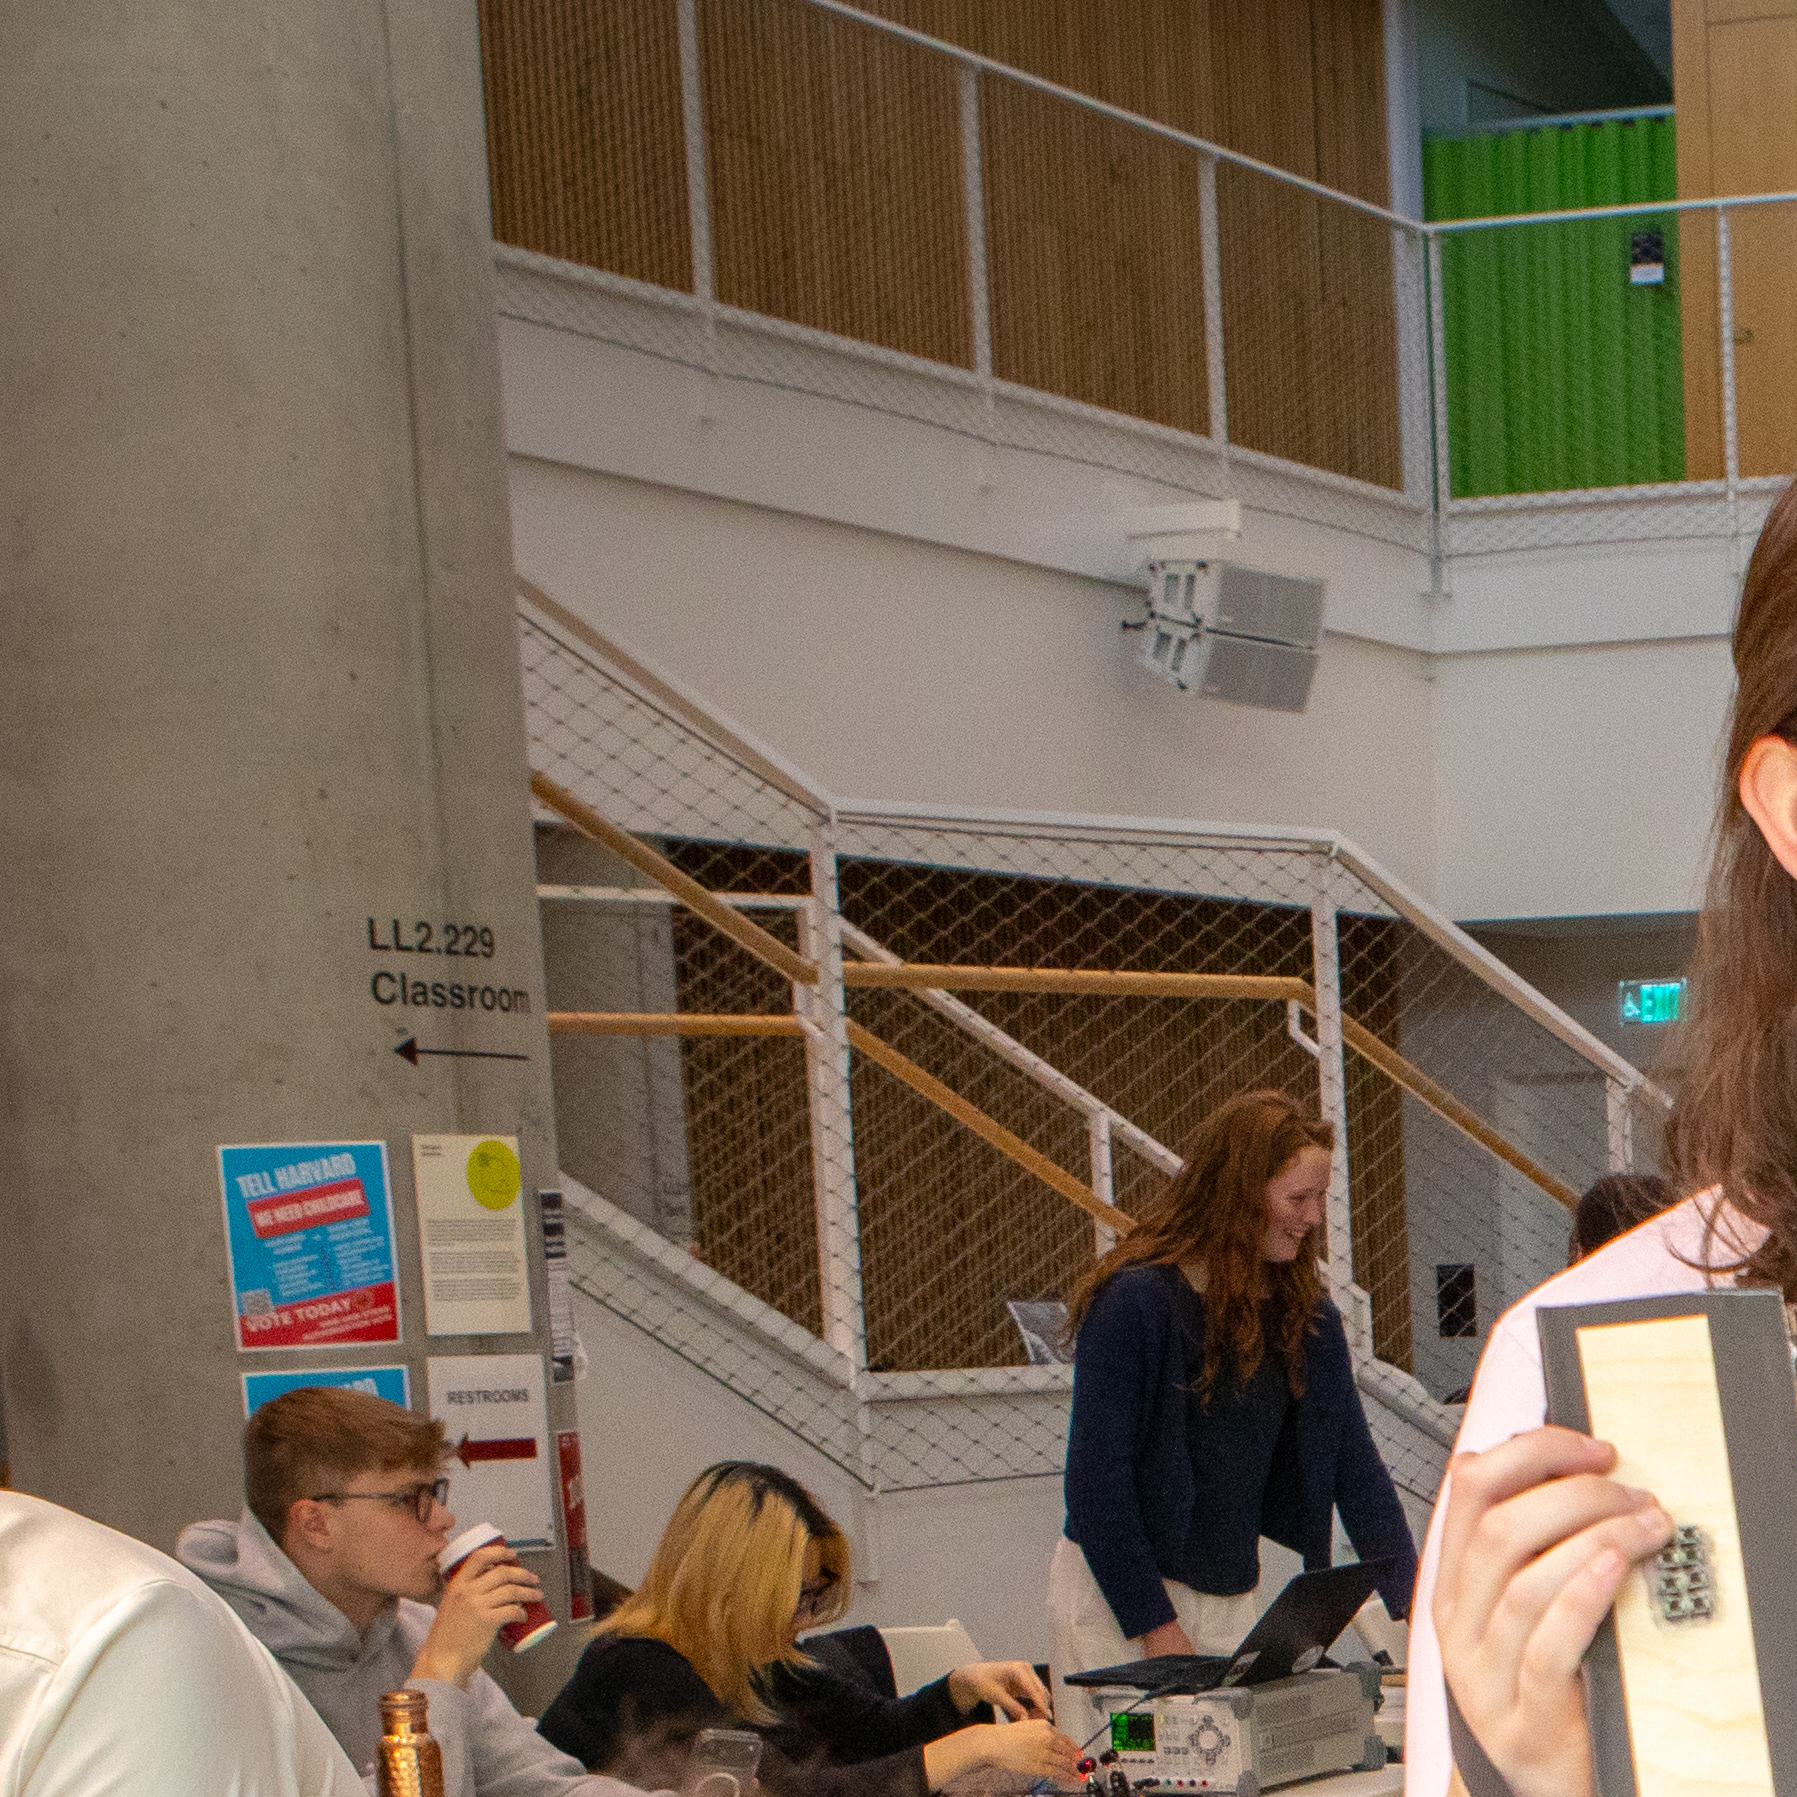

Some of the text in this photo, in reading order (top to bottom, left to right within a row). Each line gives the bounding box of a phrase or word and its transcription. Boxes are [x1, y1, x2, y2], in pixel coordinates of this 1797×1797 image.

[367, 916, 496, 959] LL2.229
[370, 970, 532, 1014] Classroom
[236, 1152, 357, 1199] TELL HARVARD
[246, 1310, 293, 1332] VOTE
[295, 1297, 351, 1321] TODAY
[446, 1388, 530, 1405] RESTROOMS
